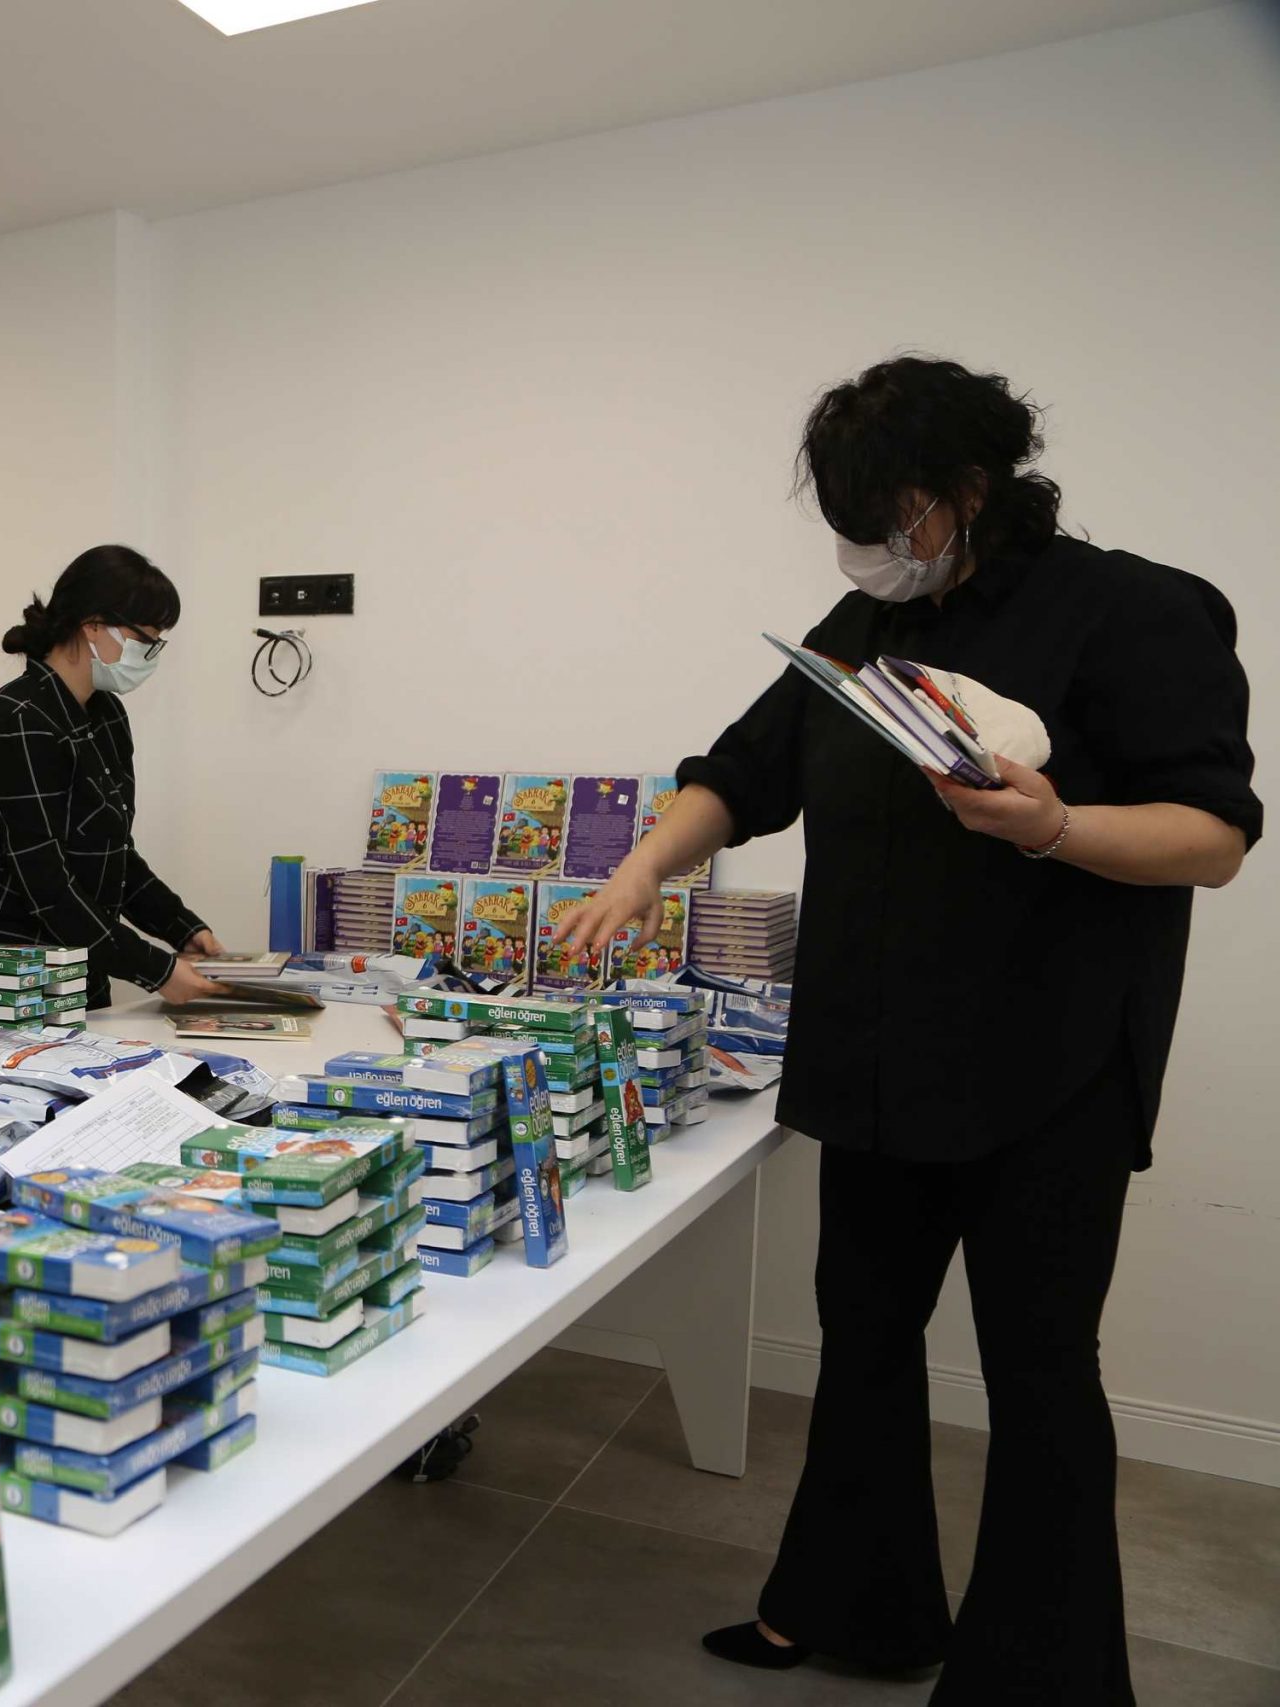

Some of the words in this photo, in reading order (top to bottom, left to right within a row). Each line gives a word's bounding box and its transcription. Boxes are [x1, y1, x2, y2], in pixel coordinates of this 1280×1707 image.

[488, 1007, 516, 1021] eğlen
[517, 1009, 546, 1025] öğren
[620, 997, 642, 1010] eğlen
[643, 998, 667, 1010] öğren
[376, 1091, 408, 1107] eğlen
[409, 1094, 443, 1109] öğren
[610, 1107, 623, 1136] eğlen
[614, 1136, 626, 1167] öğren
[521, 1168, 537, 1202] eğlen
[525, 1201, 541, 1238] öğren
